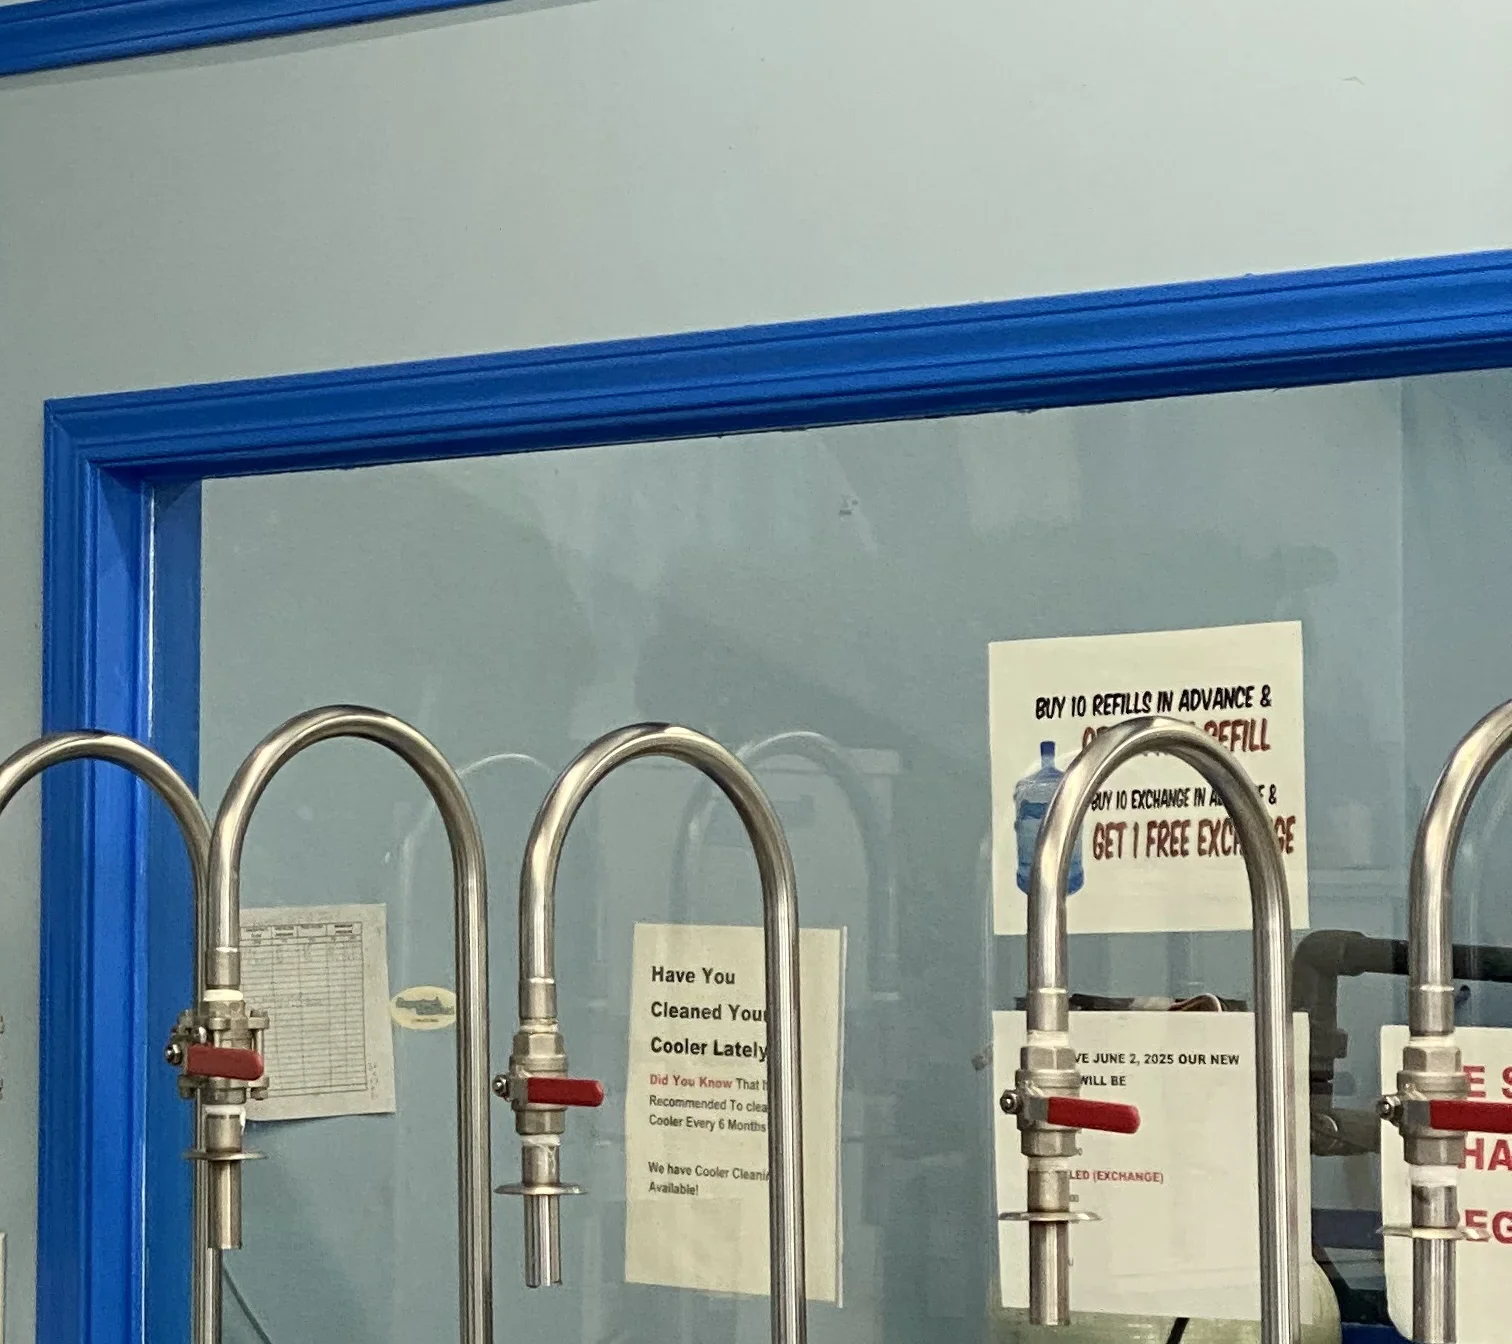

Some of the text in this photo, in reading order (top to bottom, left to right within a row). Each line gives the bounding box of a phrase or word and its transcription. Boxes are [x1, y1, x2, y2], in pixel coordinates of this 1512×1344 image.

[1036, 684, 1272, 720] BUY 10 REFILLS IN ADVANCE &
[1091, 789, 1112, 811] BUY
[1116, 789, 1128, 809] 10
[1131, 787, 1190, 810] EXCHANGE
[1194, 787, 1206, 807] IN
[1092, 821, 1128, 860] GET
[1133, 821, 1139, 859] 1
[1146, 819, 1191, 858] FREE
[651, 965, 735, 984] Have You
[651, 1001, 722, 1020] Cleaned
[651, 1036, 767, 1062] Cooler Lately
[1093, 1053, 1126, 1064] JUNE
[1129, 1054, 1140, 1066] 2,
[1144, 1054, 1174, 1064] 2025
[1178, 1054, 1206, 1065] OUR
[1210, 1054, 1240, 1065] NEW
[650, 1073, 668, 1086] Did
[673, 1075, 695, 1087] You
[699, 1076, 733, 1088] Know
[736, 1077, 759, 1090] That
[1111, 1076, 1126, 1086] BE
[649, 1095, 768, 1113] Recommended To clea
[649, 1114, 767, 1132] Cooler Every 6 Months
[648, 1161, 664, 1174] We
[667, 1163, 692, 1176] have
[695, 1165, 729, 1178] Cooler
[1093, 1170, 1164, 1184] (EXCHANGE)
[648, 1181, 699, 1196] Available!
